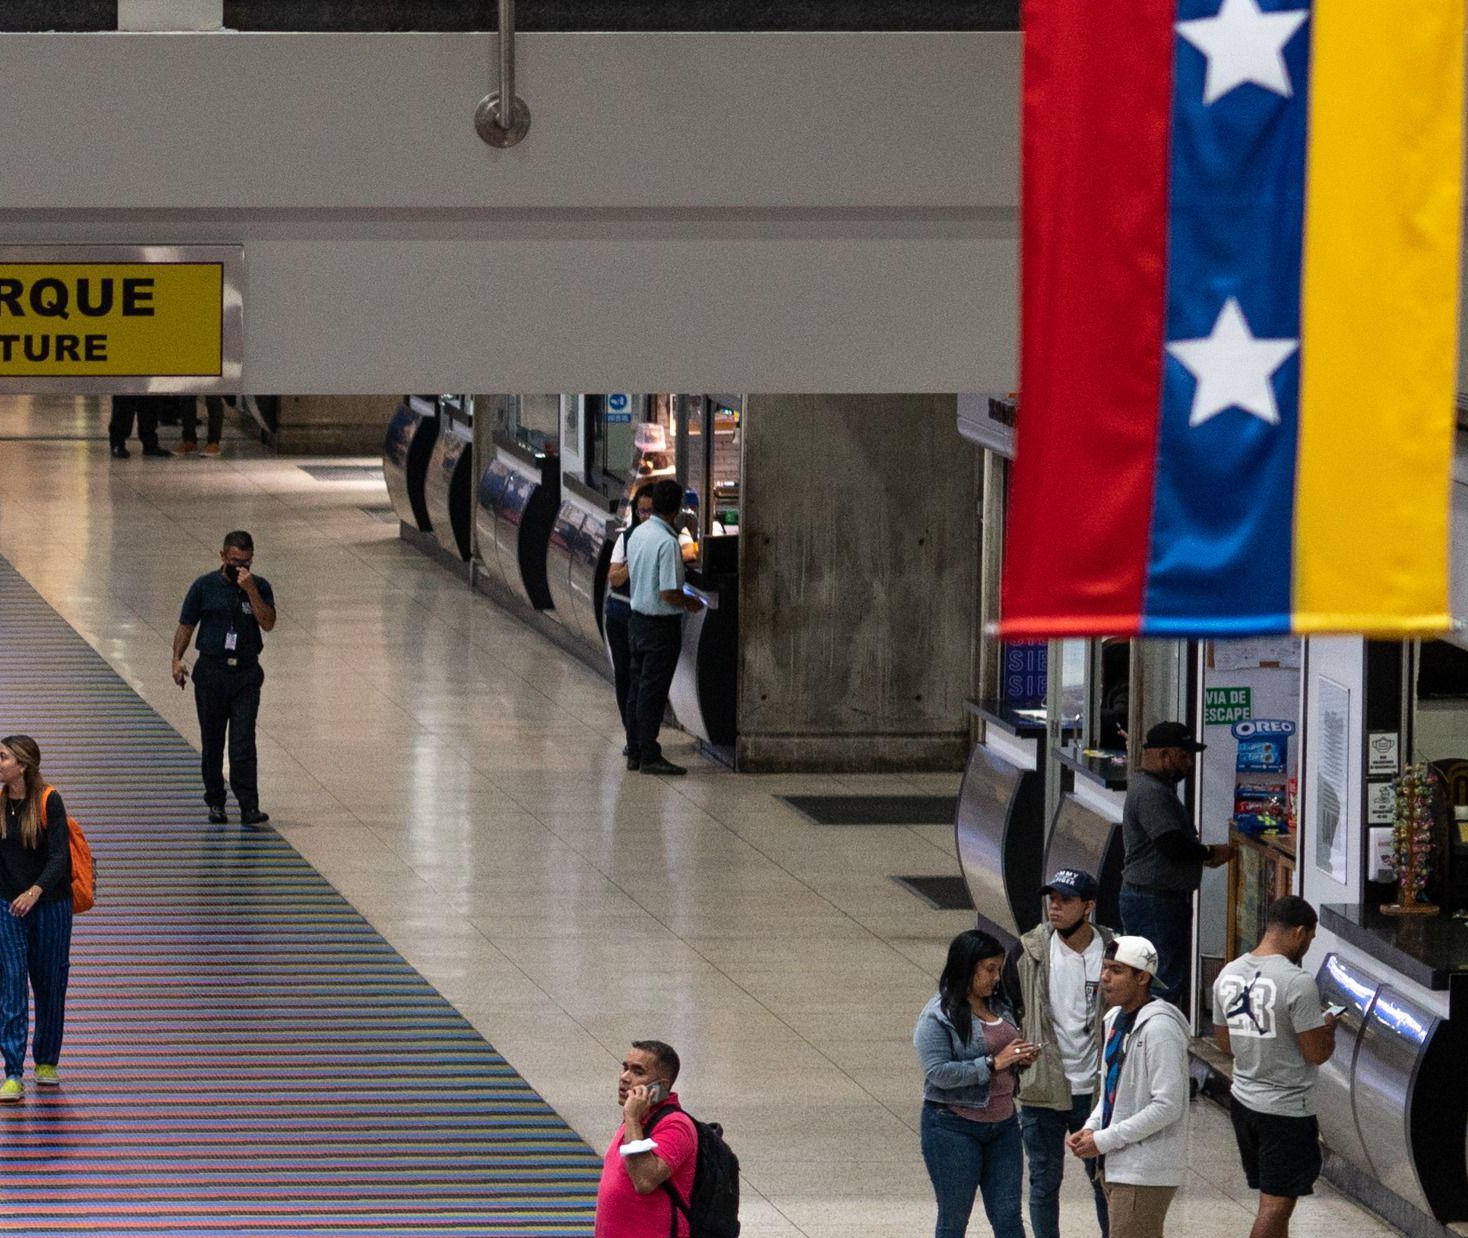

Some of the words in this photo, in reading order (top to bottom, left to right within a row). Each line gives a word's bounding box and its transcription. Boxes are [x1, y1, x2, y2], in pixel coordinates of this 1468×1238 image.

[1206, 690, 1227, 705] VIA
[1230, 690, 1246, 705] DE
[1235, 721, 1292, 736] OREO
[1218, 974, 1277, 1039] 23
